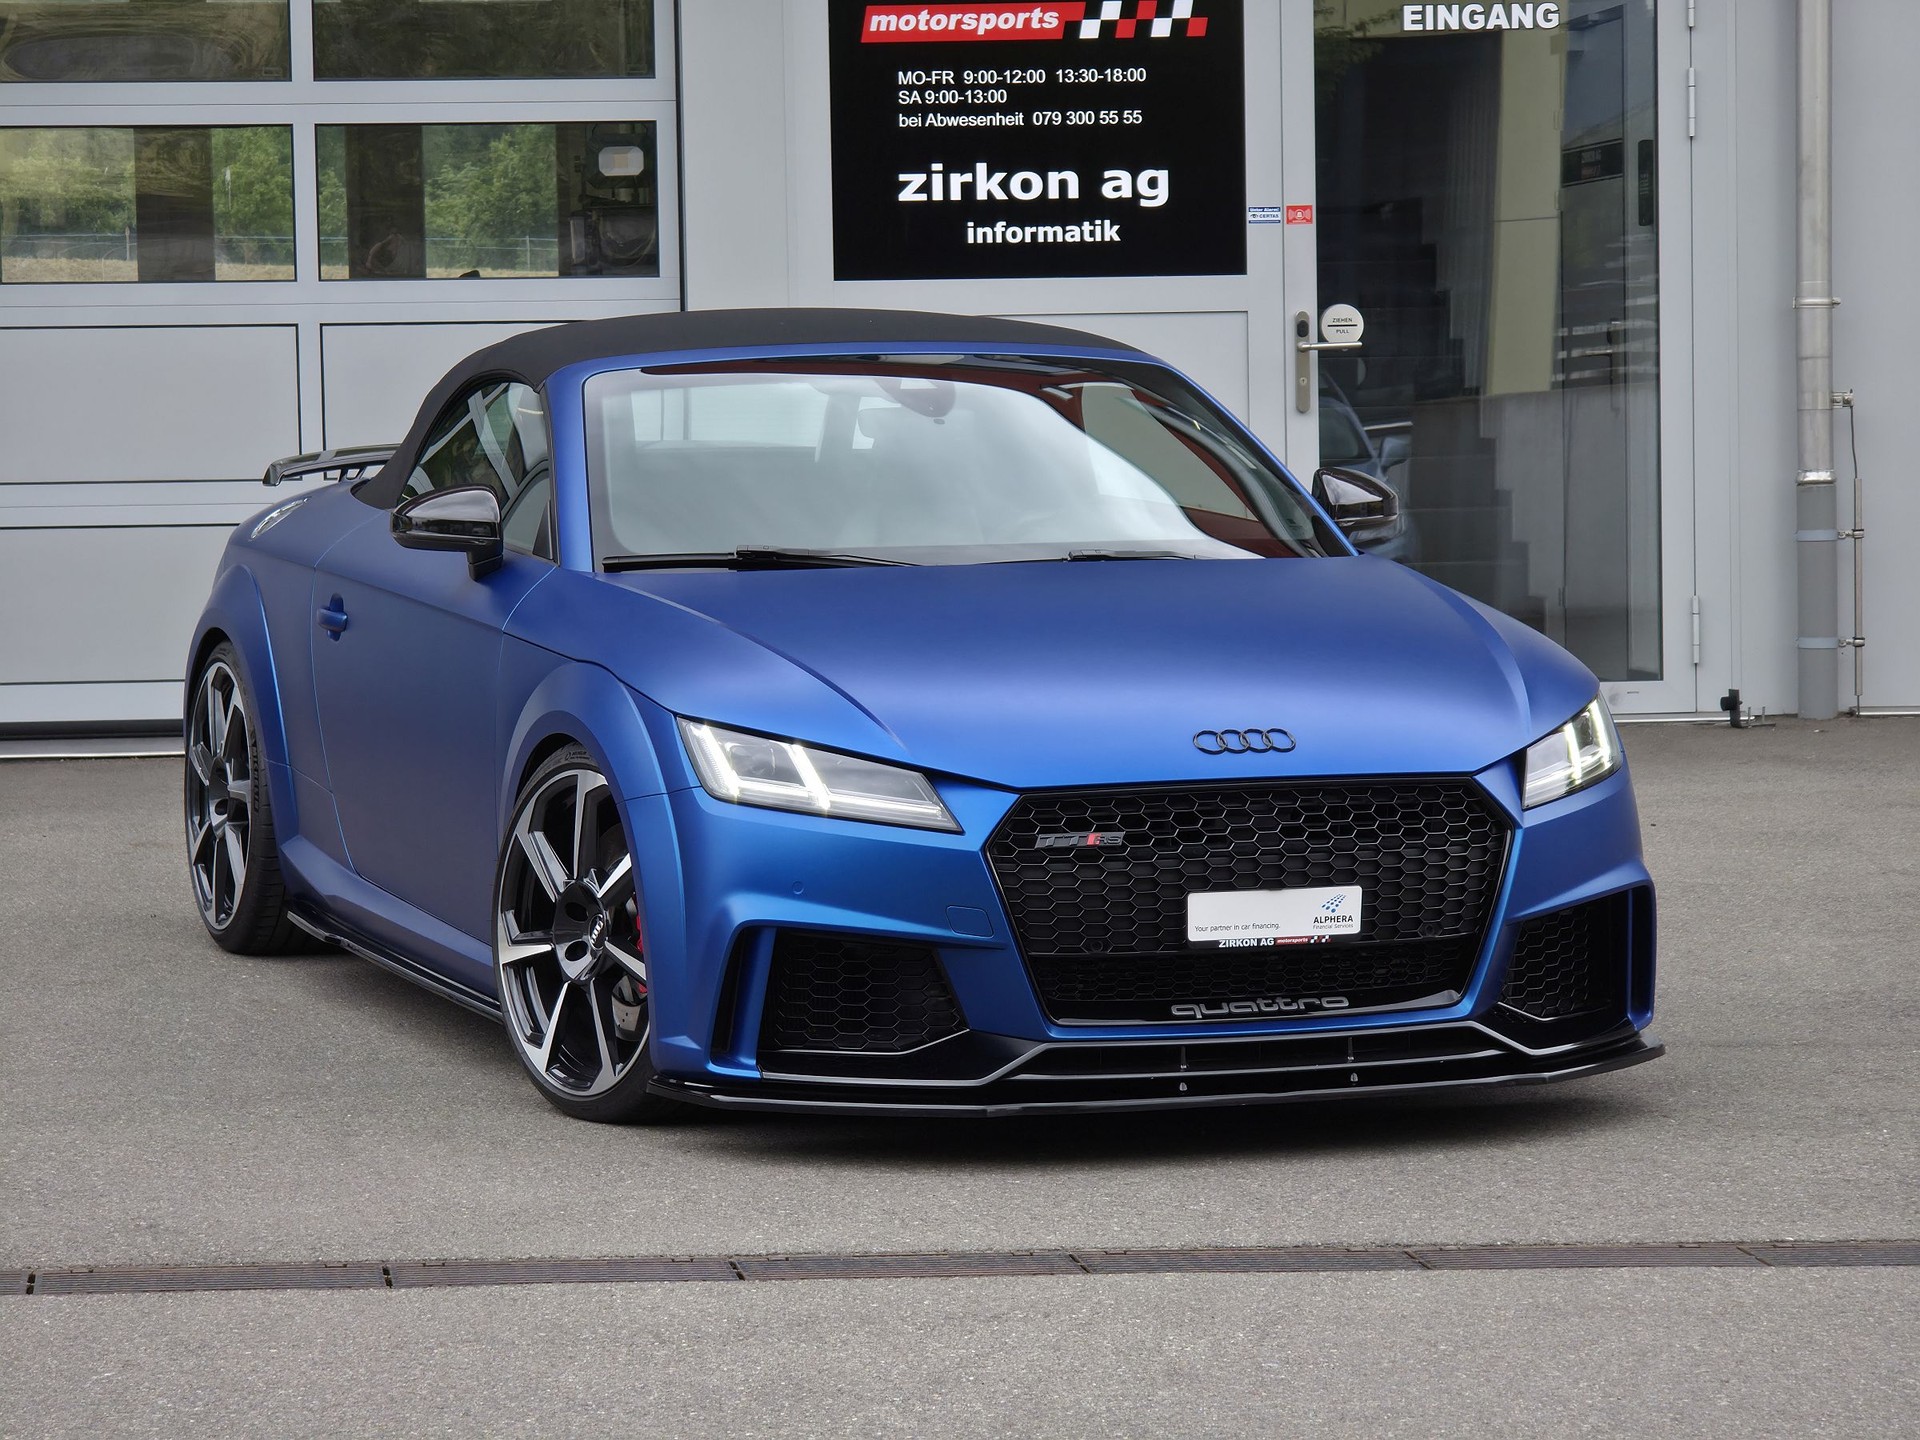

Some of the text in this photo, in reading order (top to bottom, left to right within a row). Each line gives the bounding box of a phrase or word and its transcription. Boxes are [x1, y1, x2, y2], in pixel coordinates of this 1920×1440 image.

[869, 7, 1059, 35] motorsports
[1403, 2, 1559, 31] EINGANG
[898, 68, 1147, 85] MO-FR 9:00-12:00 13:30-18:00
[898, 90, 1008, 105] SA 9:00-13:00
[898, 110, 1143, 128] bei Abwesenheit 079 300 55 55
[897, 162, 1169, 208] zirkon ag
[966, 219, 1121, 244] informatik
[1210, 924, 1233, 932] partner
[1313, 915, 1354, 924] ALPHERA
[1219, 938, 1257, 948] ZIRKON
[1260, 937, 1275, 947] AG
[1170, 996, 1350, 1019] quattro
